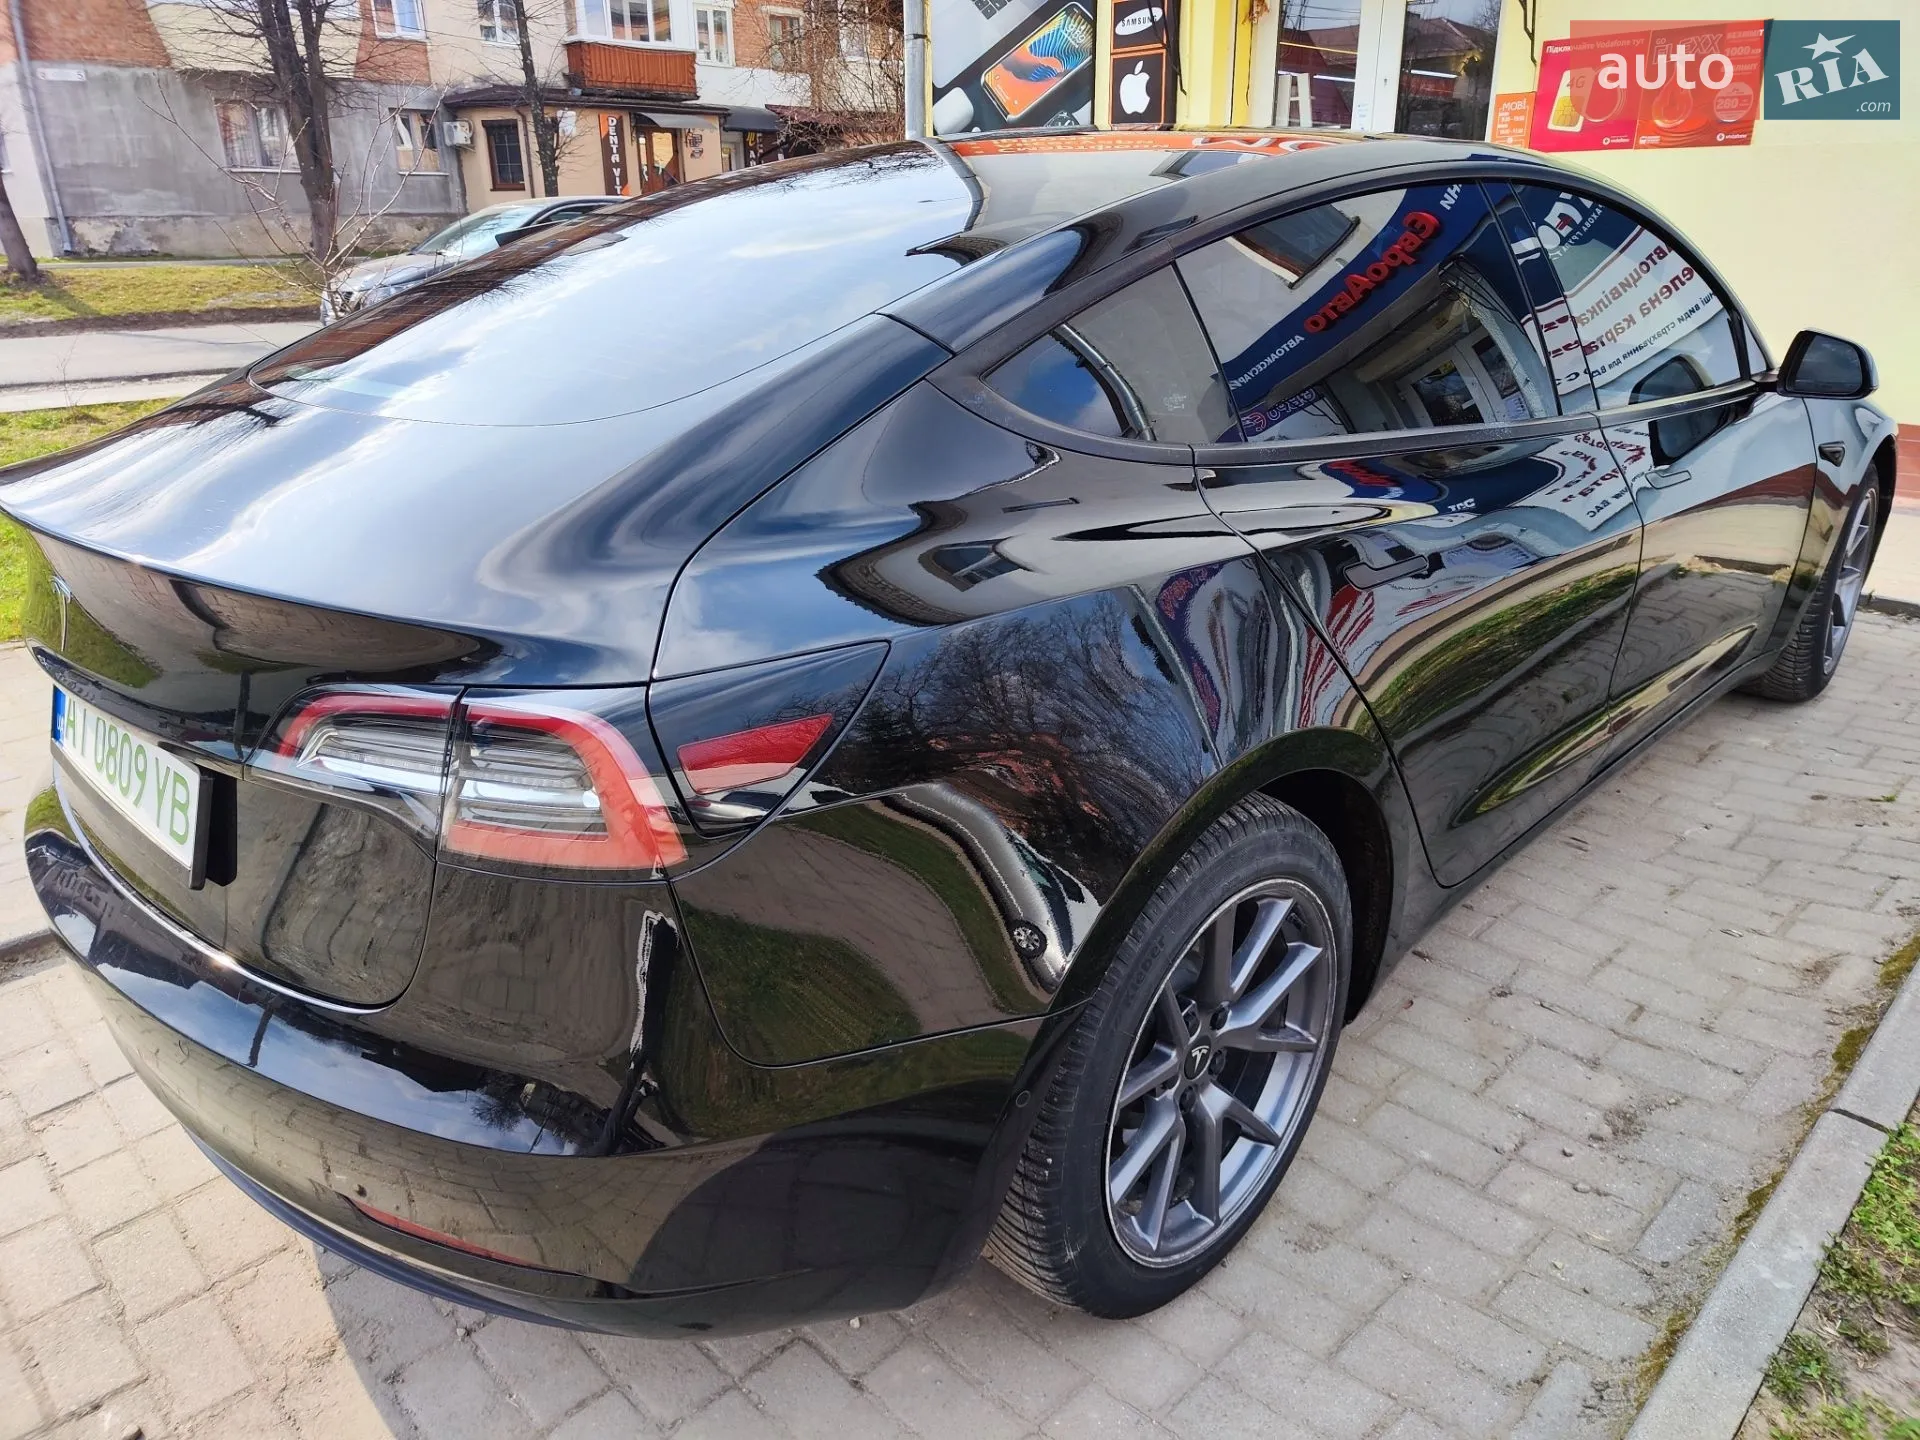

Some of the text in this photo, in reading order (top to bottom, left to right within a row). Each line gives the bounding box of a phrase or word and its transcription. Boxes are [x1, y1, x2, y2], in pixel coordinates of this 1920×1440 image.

[1596, 39, 1631, 49] Vodafone
[1632, 38, 1645, 46] тут
[1567, 75, 1586, 88] 4G
[608, 116, 622, 195] DENTA VIT
[94, 716, 147, 808] 0809
[155, 756, 190, 846] YB
